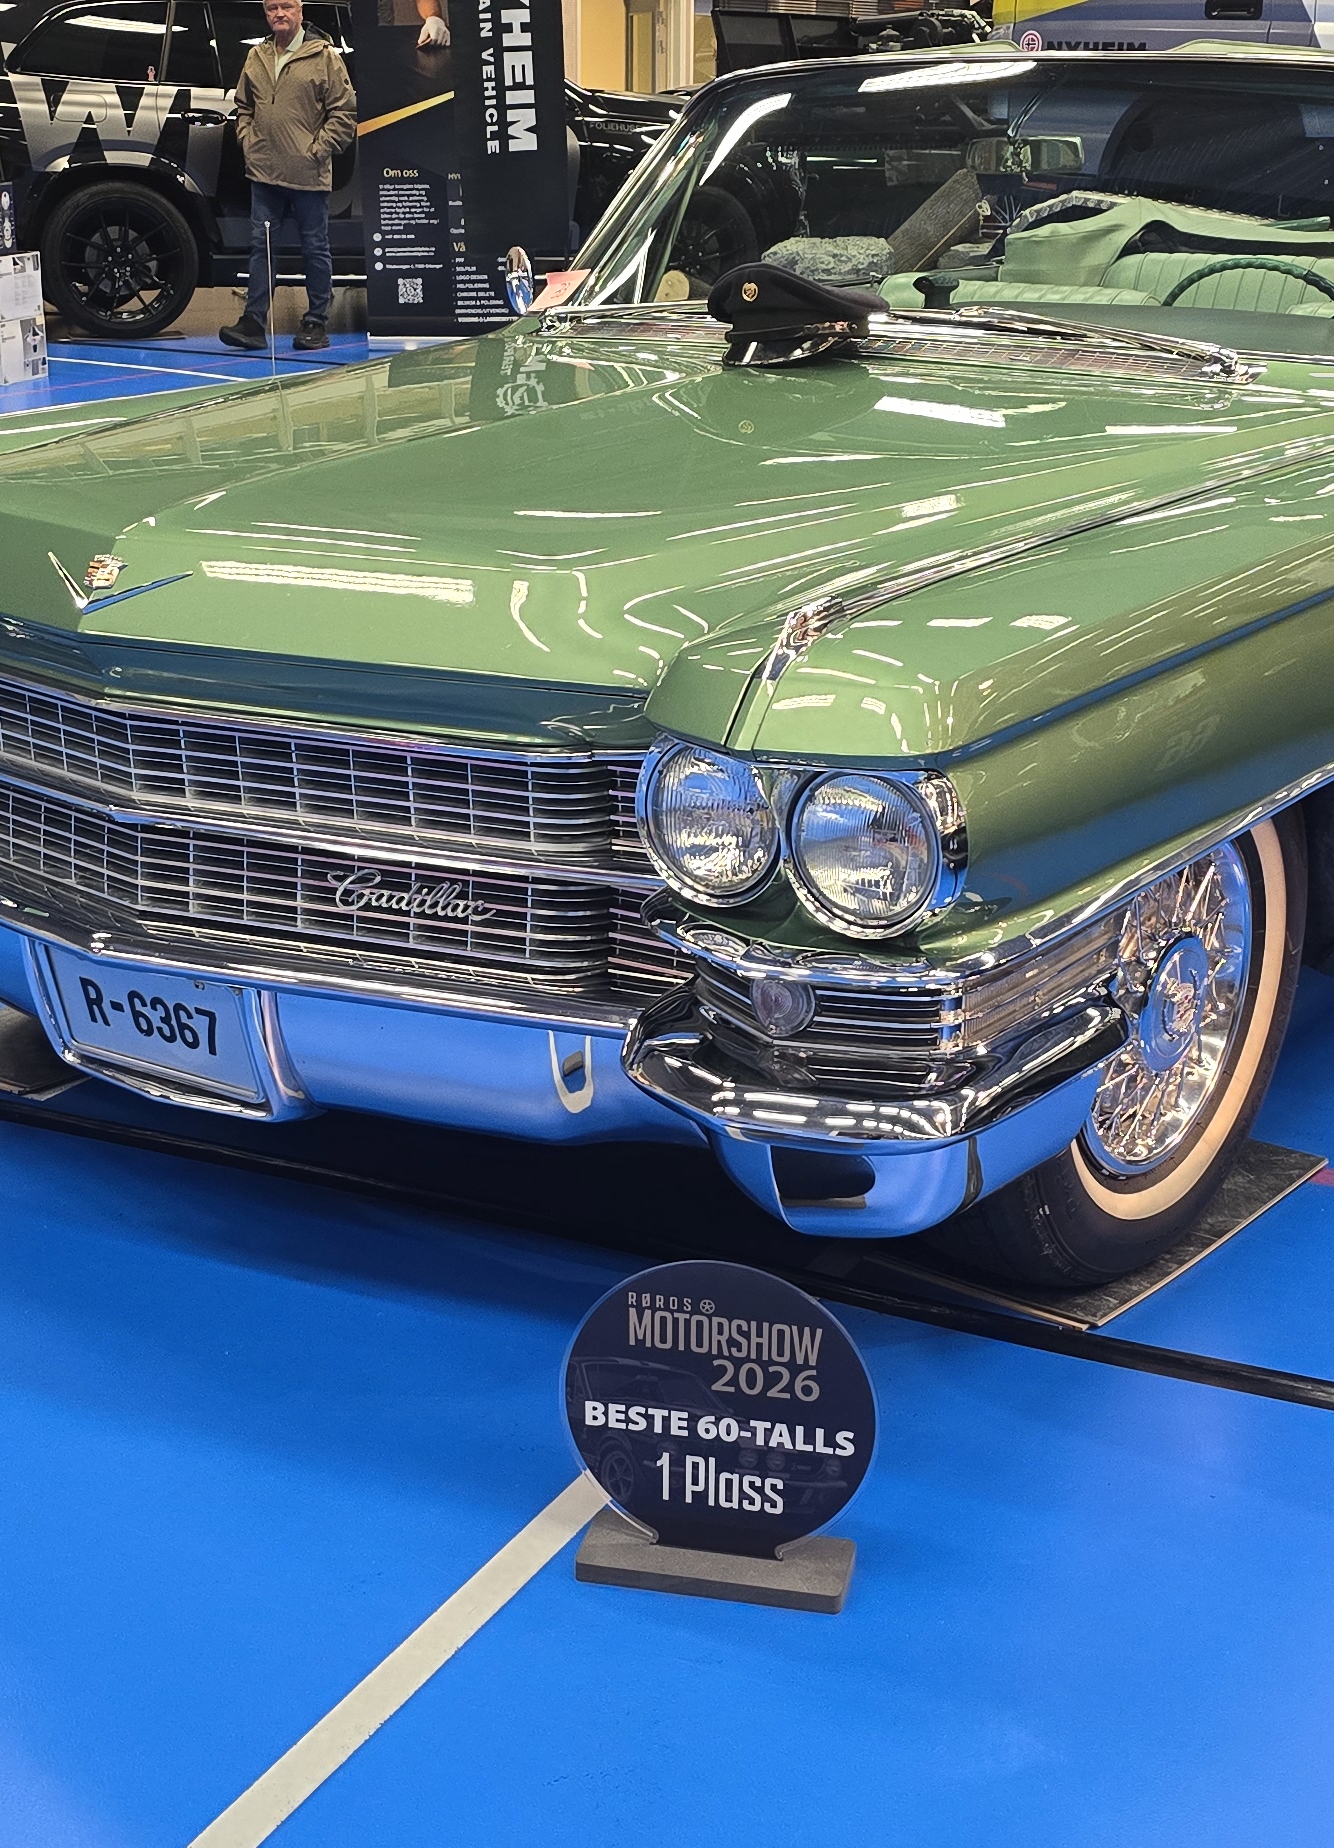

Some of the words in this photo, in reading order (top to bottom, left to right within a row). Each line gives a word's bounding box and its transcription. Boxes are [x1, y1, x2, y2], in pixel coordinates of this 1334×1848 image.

[481, 48, 500, 155] VEHICLE
[500, 0, 538, 152] HEIM
[383, 168, 401, 178] Om
[403, 169, 419, 177] oss
[328, 868, 497, 922] Cadillac
[78, 976, 218, 1056] R-6367
[628, 1292, 692, 1311] RØROS
[628, 1307, 823, 1367] MOTORSHOW
[710, 1359, 821, 1402] 2026
[584, 1401, 689, 1437] BESTE
[696, 1415, 856, 1457] 60-TALLS
[656, 1452, 670, 1501] 1
[685, 1454, 785, 1515] Plass
